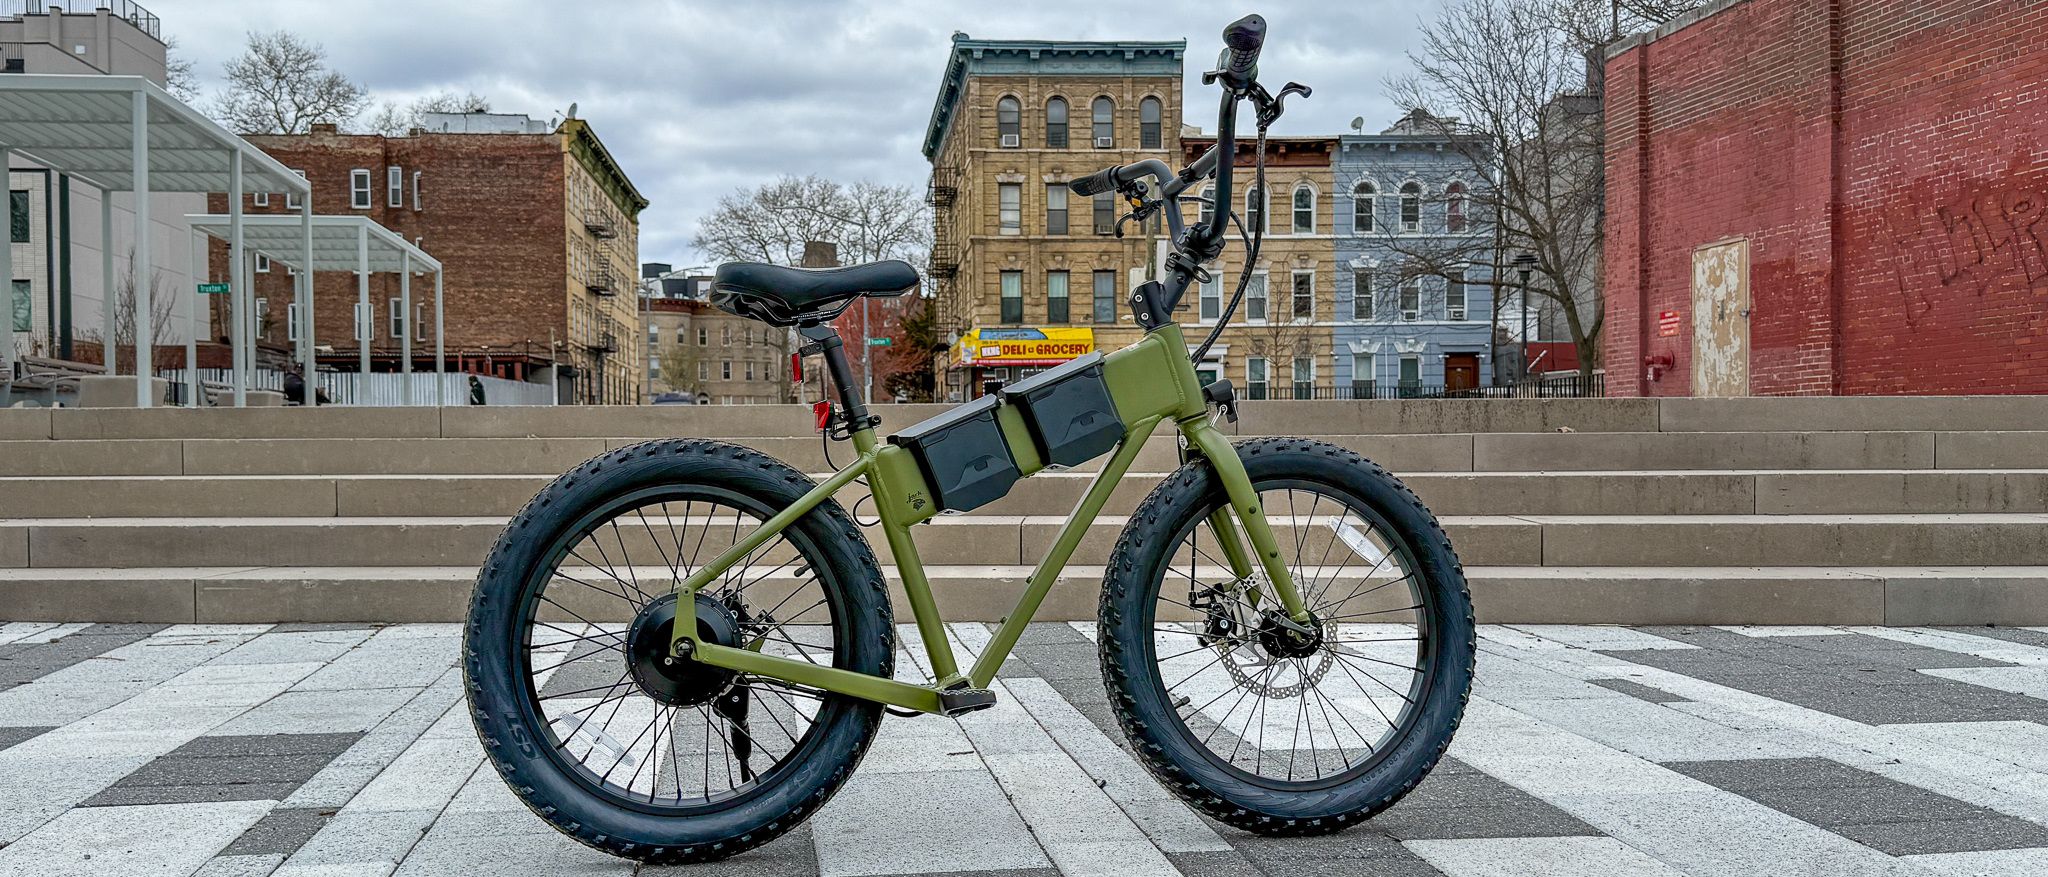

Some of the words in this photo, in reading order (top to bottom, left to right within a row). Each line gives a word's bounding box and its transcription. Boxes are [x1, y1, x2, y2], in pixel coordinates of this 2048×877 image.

[1002, 344, 1027, 356] DELI
[1036, 343, 1091, 356] GROCERY
[503, 711, 542, 761] CST
